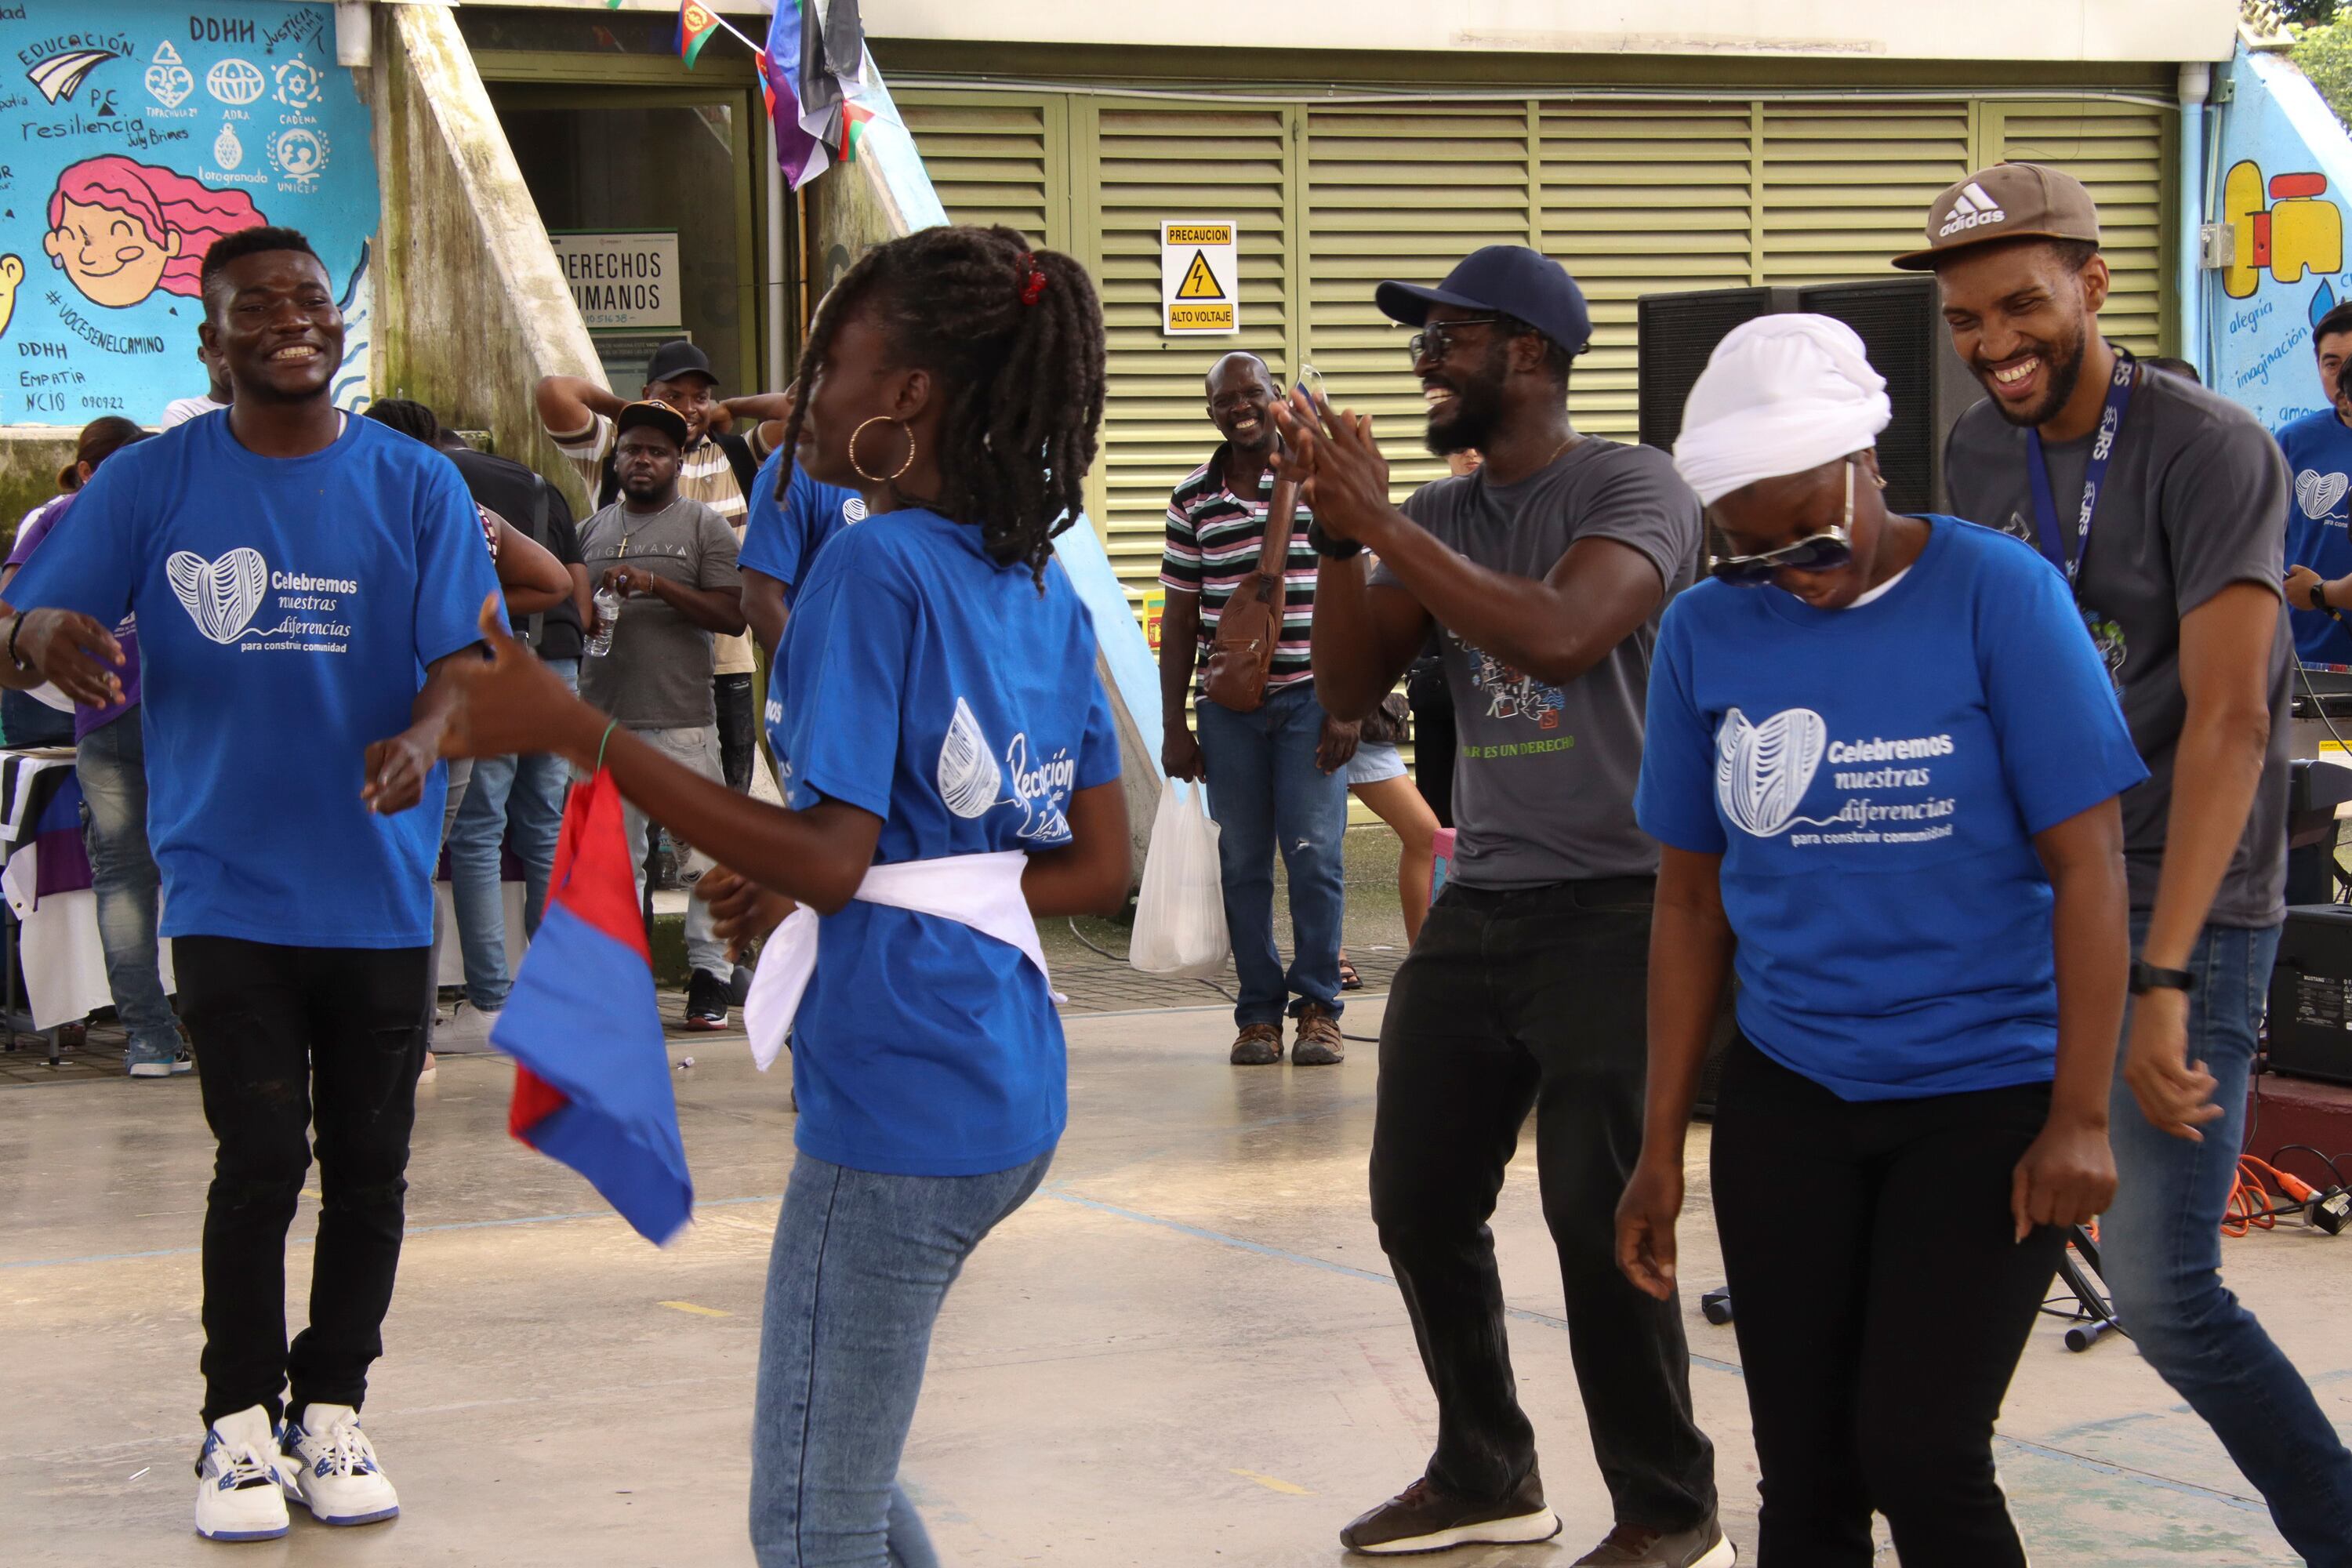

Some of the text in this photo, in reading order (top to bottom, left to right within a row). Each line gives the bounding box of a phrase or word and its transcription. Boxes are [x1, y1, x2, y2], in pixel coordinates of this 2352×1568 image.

[191, 16, 255, 43] DDHH
[17, 33, 134, 66] EDUCACIÓN
[223, 110, 250, 120] ADRA
[279, 114, 317, 124] CADENA
[22, 114, 144, 141] resiliencia
[128, 132, 147, 149] July
[278, 182, 318, 194] UNICEF
[1170, 230, 1228, 241] PRECAUCION
[1939, 210, 2005, 238] adidas
[571, 285, 660, 310] UMANOS
[45, 290, 164, 354] #VOCESENELCAMINO
[1171, 311, 1231, 322] ALTO VOLTAJE
[2229, 298, 2273, 333] alegría
[18, 342, 67, 360] DDHH
[2236, 326, 2307, 389] imaginación
[2092, 427, 2115, 461] JRS
[2078, 501, 2092, 536] JRS
[271, 571, 358, 594] Celebremos
[278, 595, 337, 612] nuestras
[241, 641, 347, 653] para construir comunidad
[1484, 746, 1497, 758] ES
[1501, 744, 1518, 757] UN
[1520, 735, 1575, 754] DERECHO
[1828, 734, 1955, 764] Celebremos
[1834, 767, 1930, 789] nuestras
[1790, 823, 1953, 848] para construir comunidad
